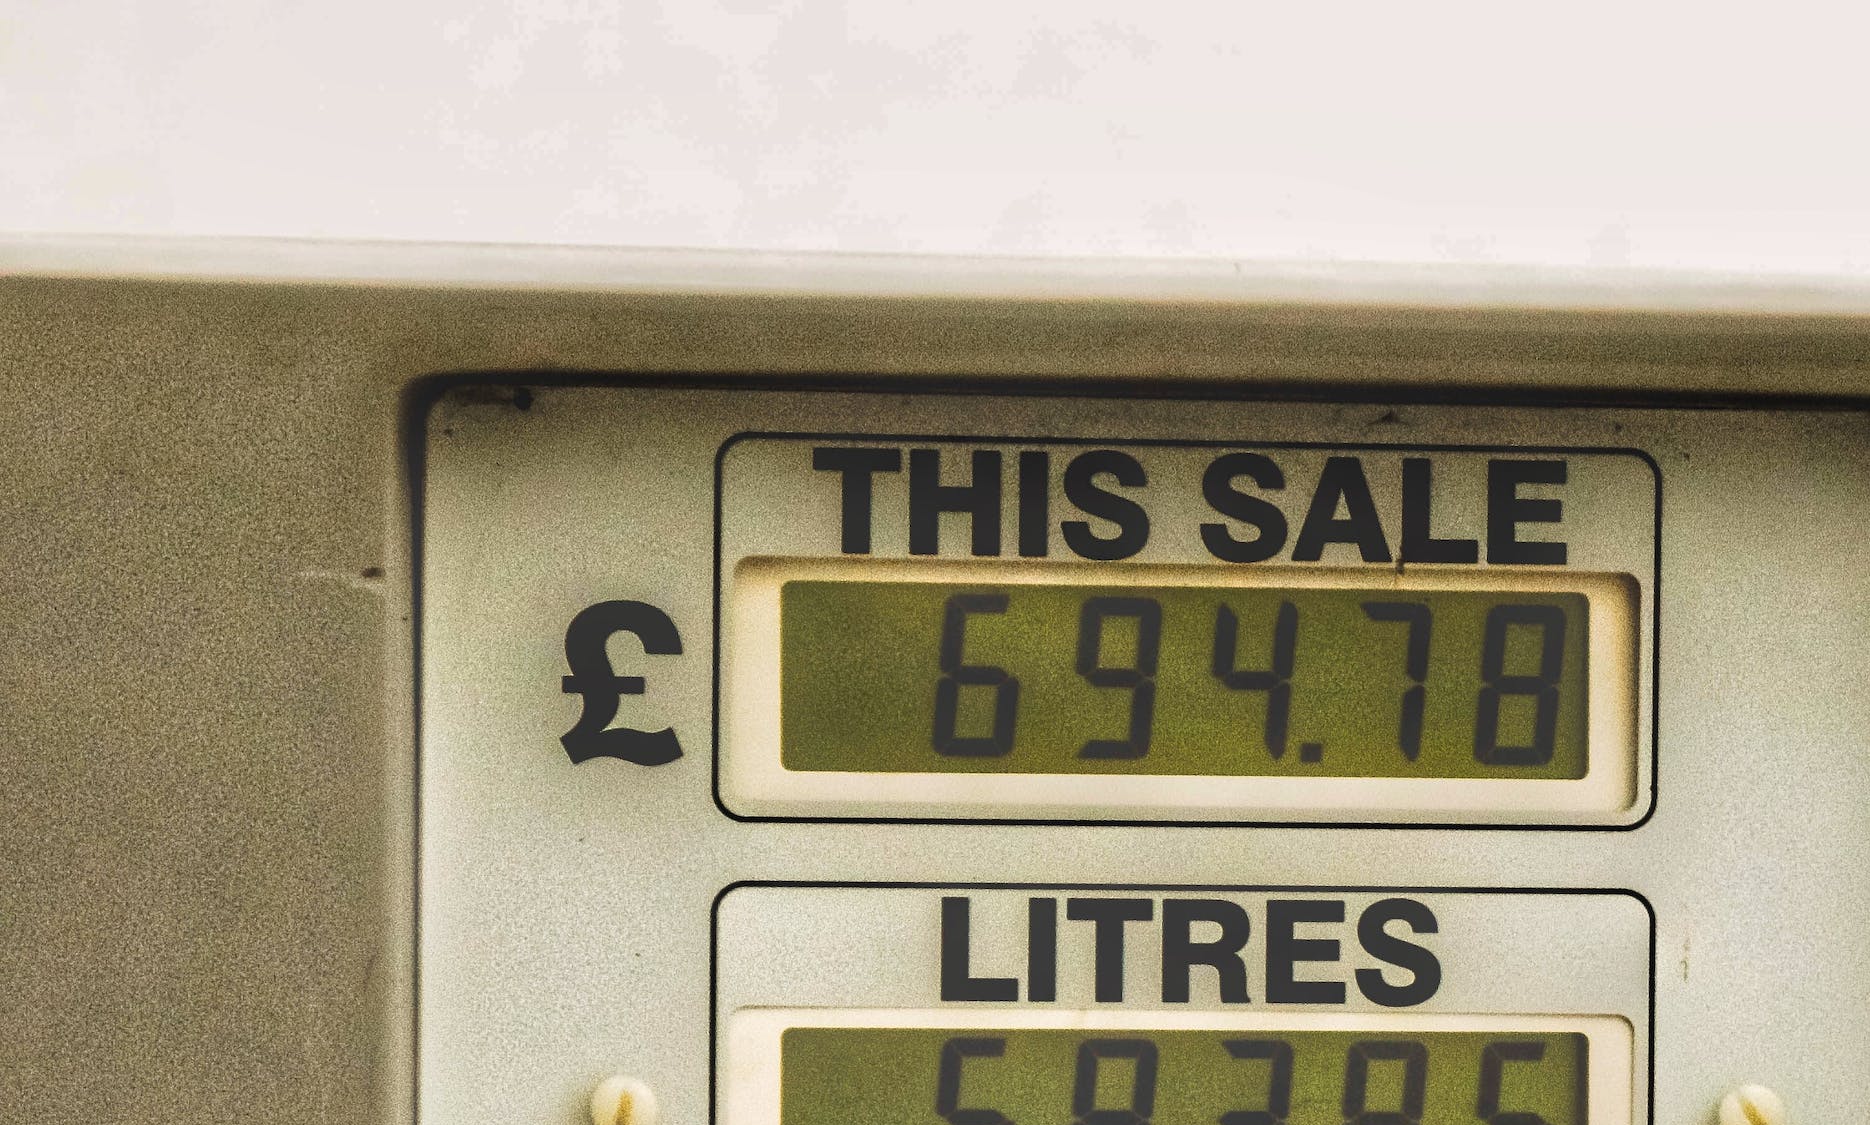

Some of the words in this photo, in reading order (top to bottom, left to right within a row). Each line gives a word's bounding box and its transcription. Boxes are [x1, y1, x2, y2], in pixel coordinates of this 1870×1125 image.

[813, 447, 1150, 561] THIS
[1200, 452, 1568, 566] SALE
[560, 599, 684, 767] £
[931, 592, 1566, 767] 694.78
[940, 896, 1442, 1007] LITRES
